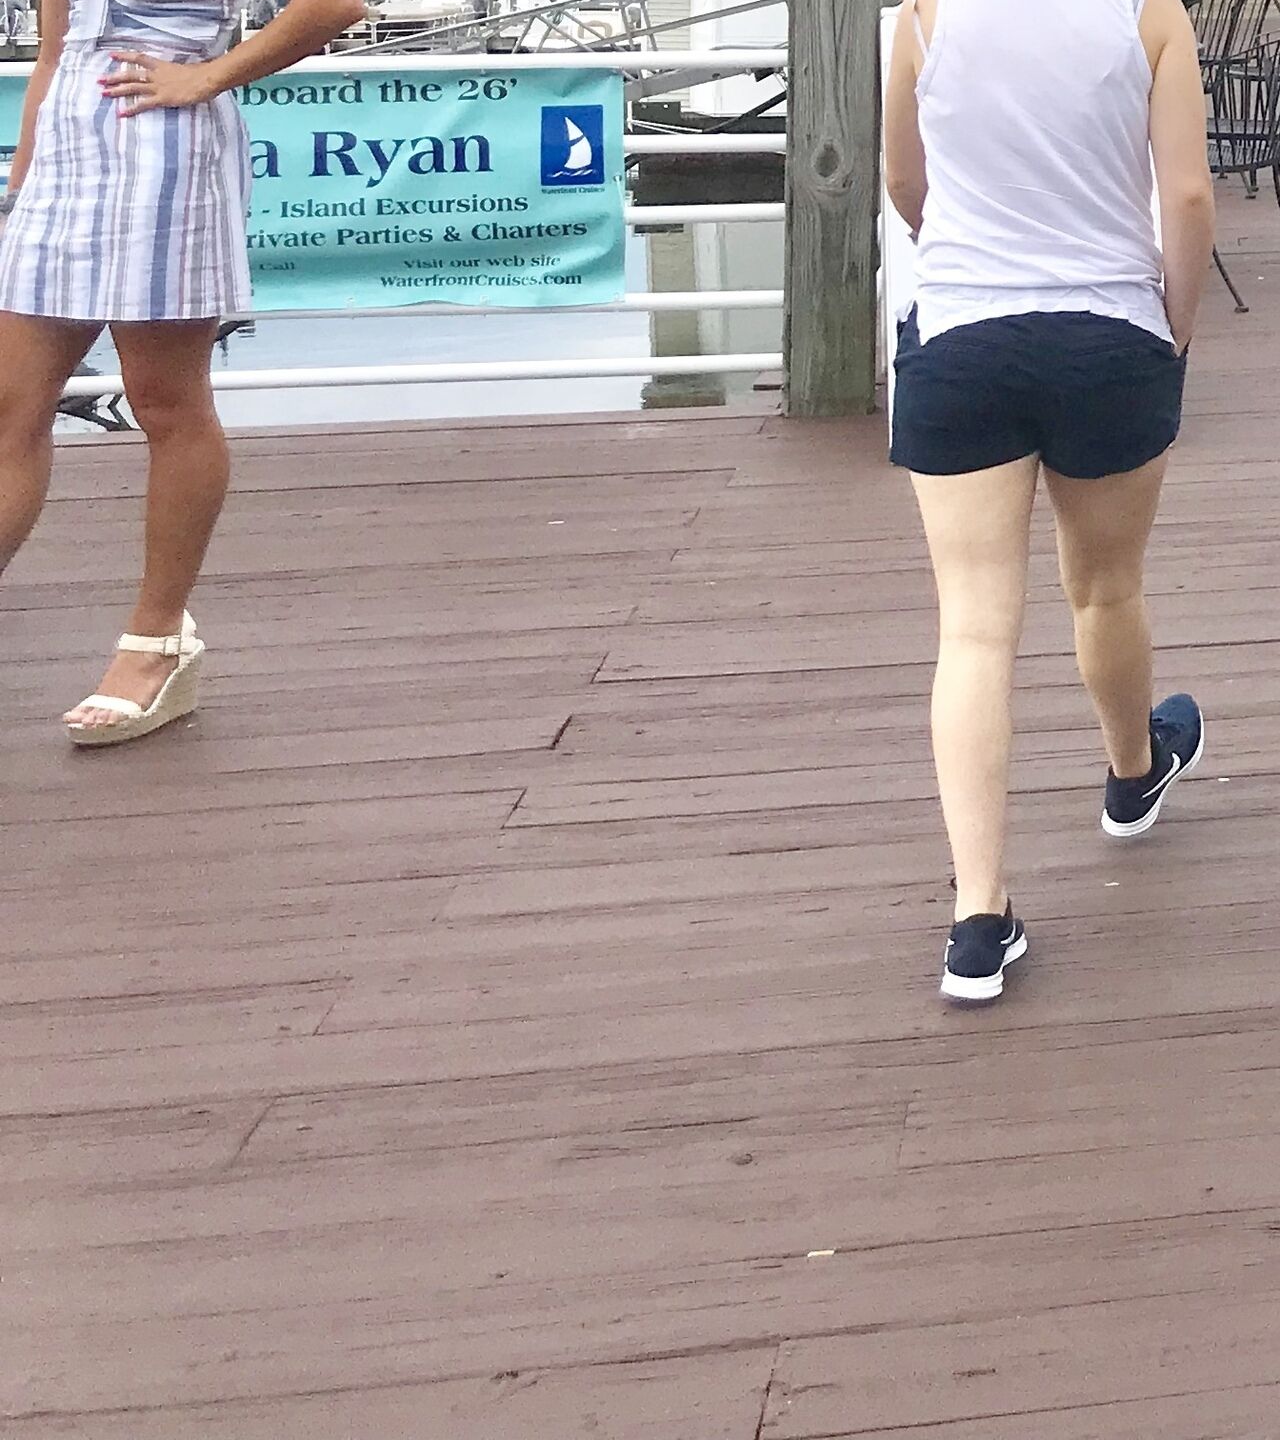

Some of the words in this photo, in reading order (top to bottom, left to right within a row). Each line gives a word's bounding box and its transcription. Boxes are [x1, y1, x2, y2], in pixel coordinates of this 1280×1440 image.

[234, 79, 364, 106] board
[378, 79, 443, 103] the
[250, 139, 282, 179] a
[309, 131, 494, 188] Ryan
[280, 198, 366, 218] Island
[376, 194, 528, 216] Excursions
[246, 229, 326, 249] rivate
[337, 225, 433, 246] Parties
[442, 225, 461, 242] &
[471, 222, 587, 241] Charters
[259, 262, 295, 271] Call
[403, 258, 443, 269] Visit
[450, 259, 480, 268] our
[488, 255, 525, 267] web
[530, 254, 561, 266] site
[380, 273, 582, 288] WaterfrontCruises.com
